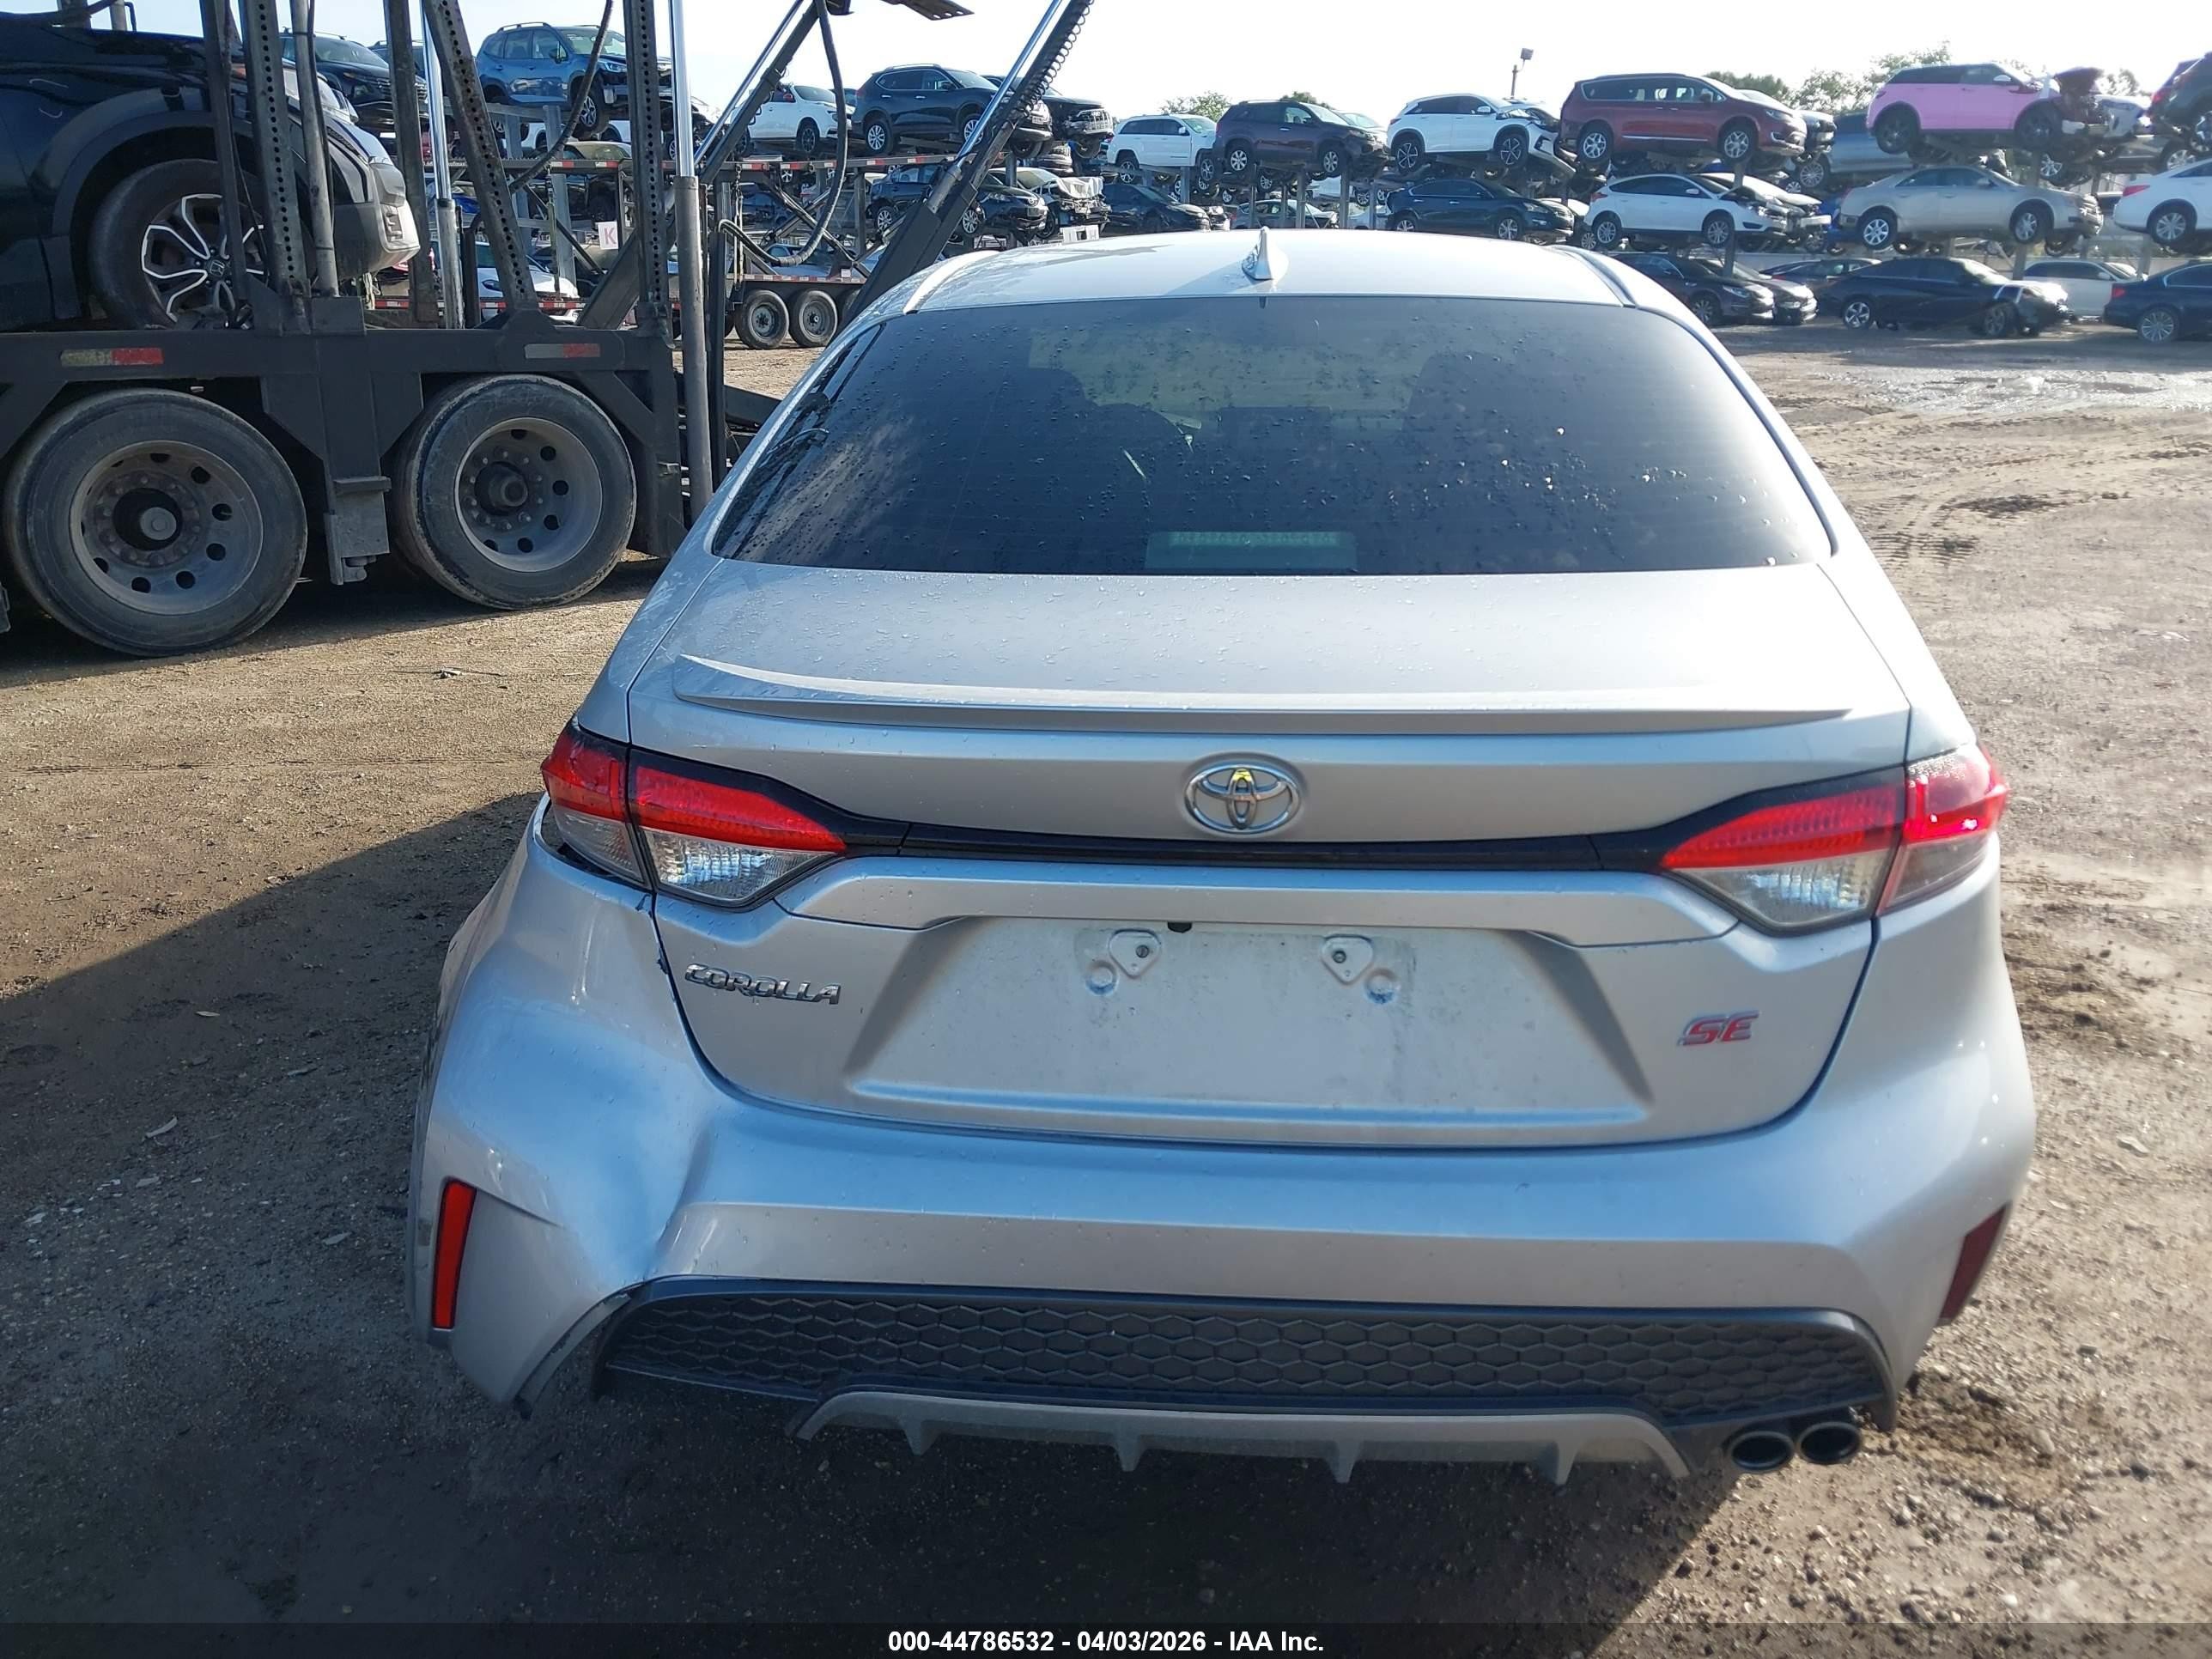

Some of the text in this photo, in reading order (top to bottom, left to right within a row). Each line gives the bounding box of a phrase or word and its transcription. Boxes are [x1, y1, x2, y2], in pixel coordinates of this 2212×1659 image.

[604, 227, 617, 245] K
[684, 963, 842, 1006] COROLLA
[1677, 1010, 1760, 1047] SE
